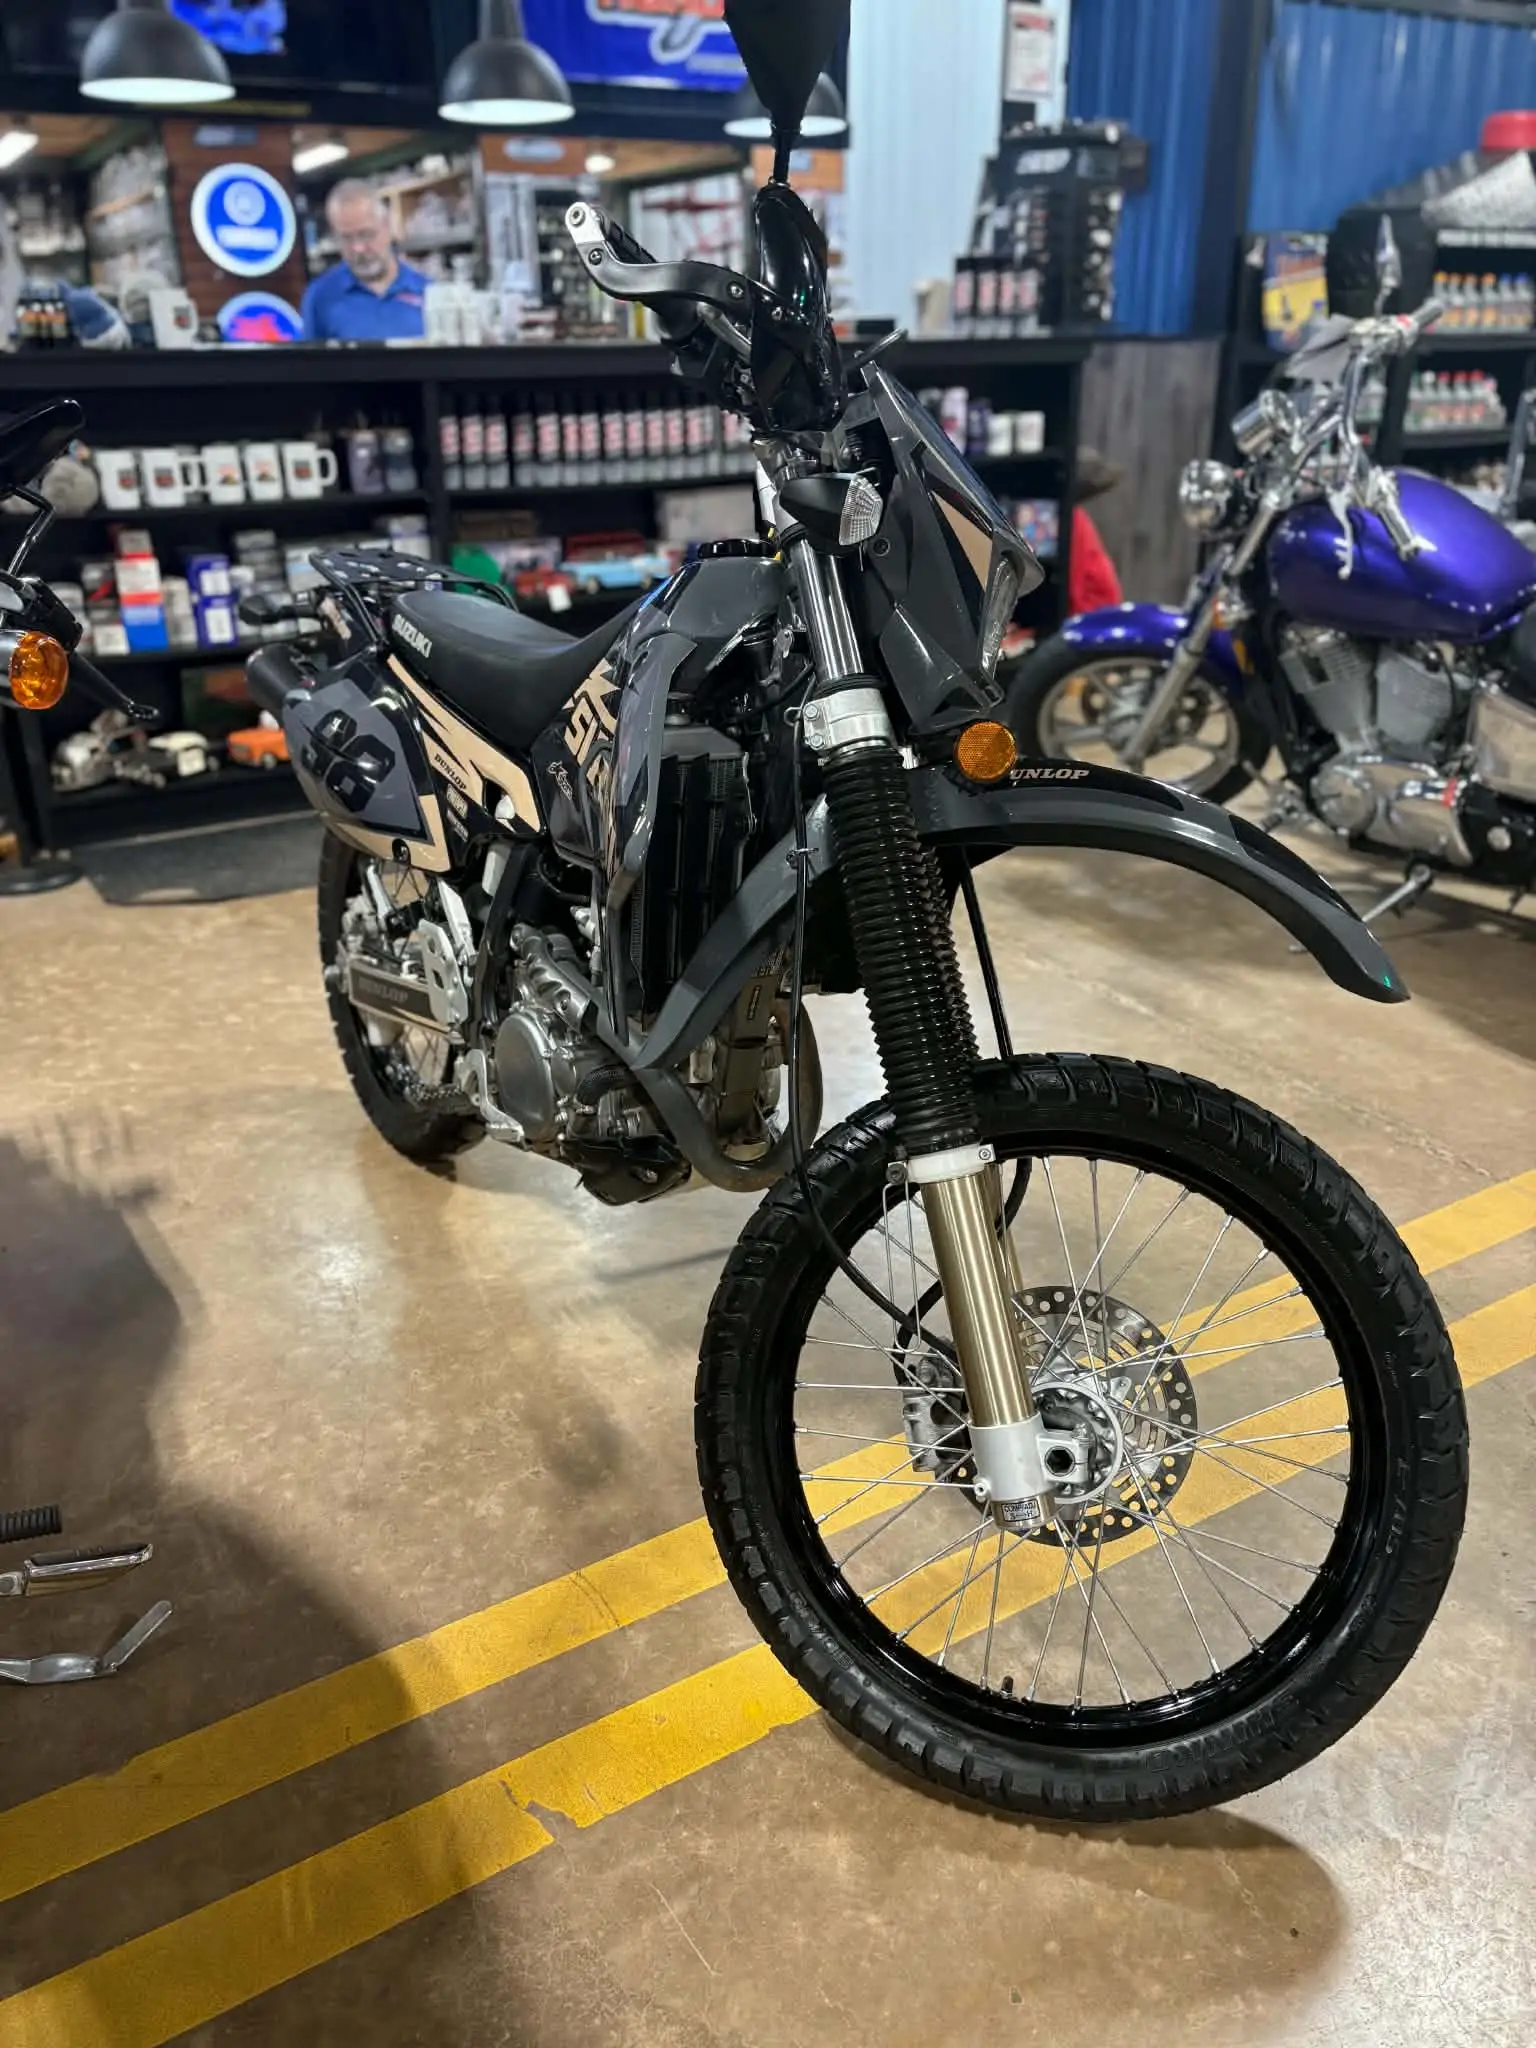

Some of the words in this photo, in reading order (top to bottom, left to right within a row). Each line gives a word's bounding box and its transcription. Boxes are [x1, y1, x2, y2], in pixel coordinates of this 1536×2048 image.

[391, 613, 433, 658] SUZUKI
[434, 753, 467, 790] DUNLOP
[1009, 768, 1090, 780] UNLOP
